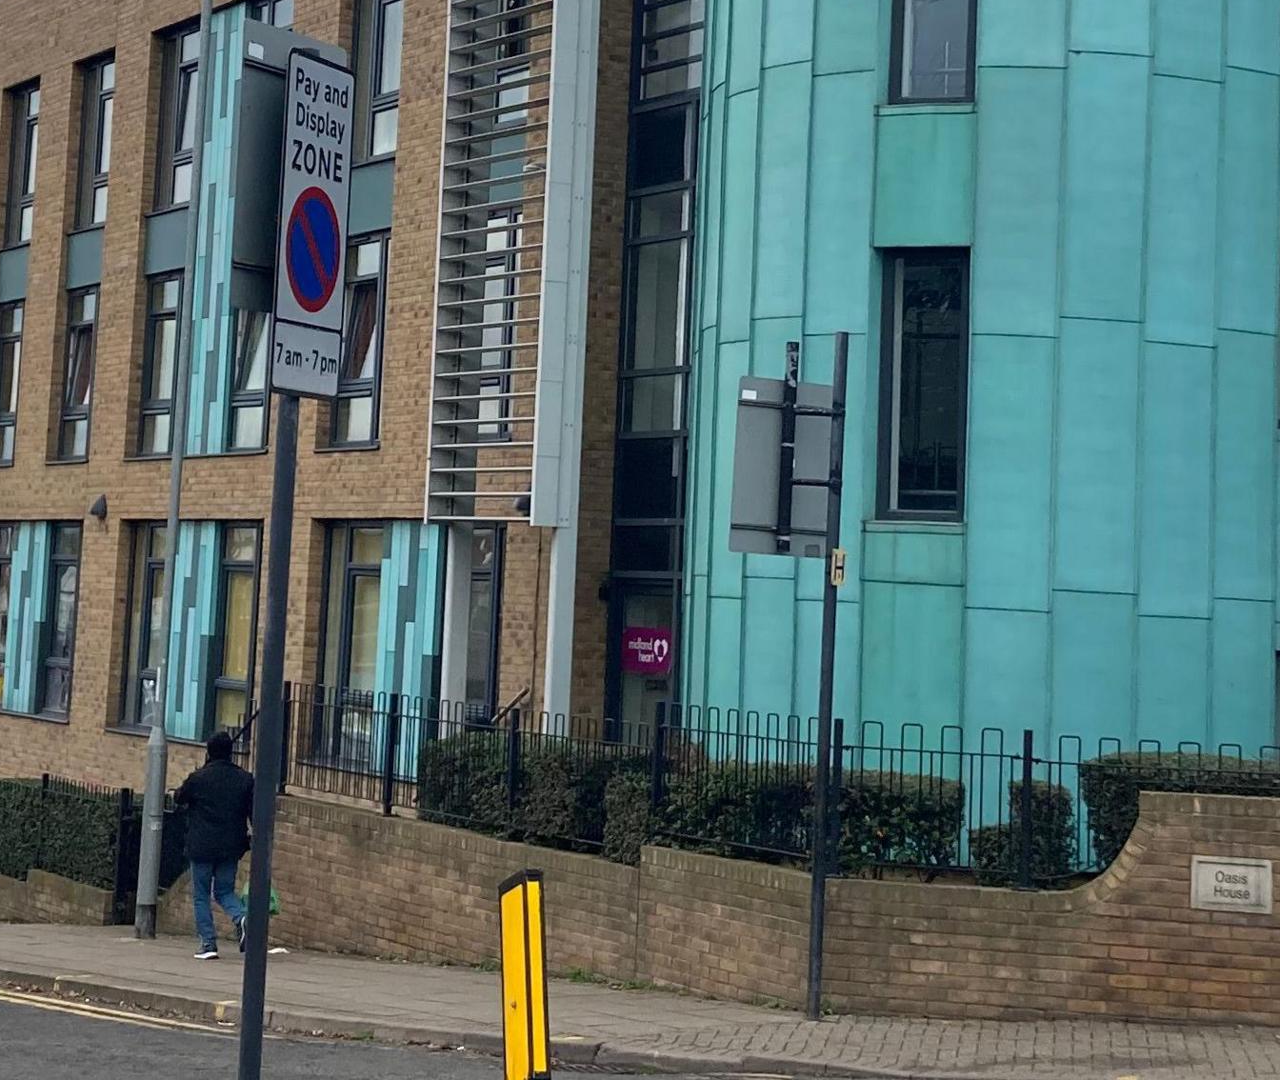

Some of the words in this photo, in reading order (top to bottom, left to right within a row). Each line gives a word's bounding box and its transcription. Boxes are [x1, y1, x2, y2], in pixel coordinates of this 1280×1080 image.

[295, 67, 320, 103] Pay
[324, 84, 349, 109] and
[295, 101, 345, 145] Display
[291, 139, 343, 183] ZONE
[1214, 886, 1250, 899] House
[1215, 870, 1248, 884] Oasis
